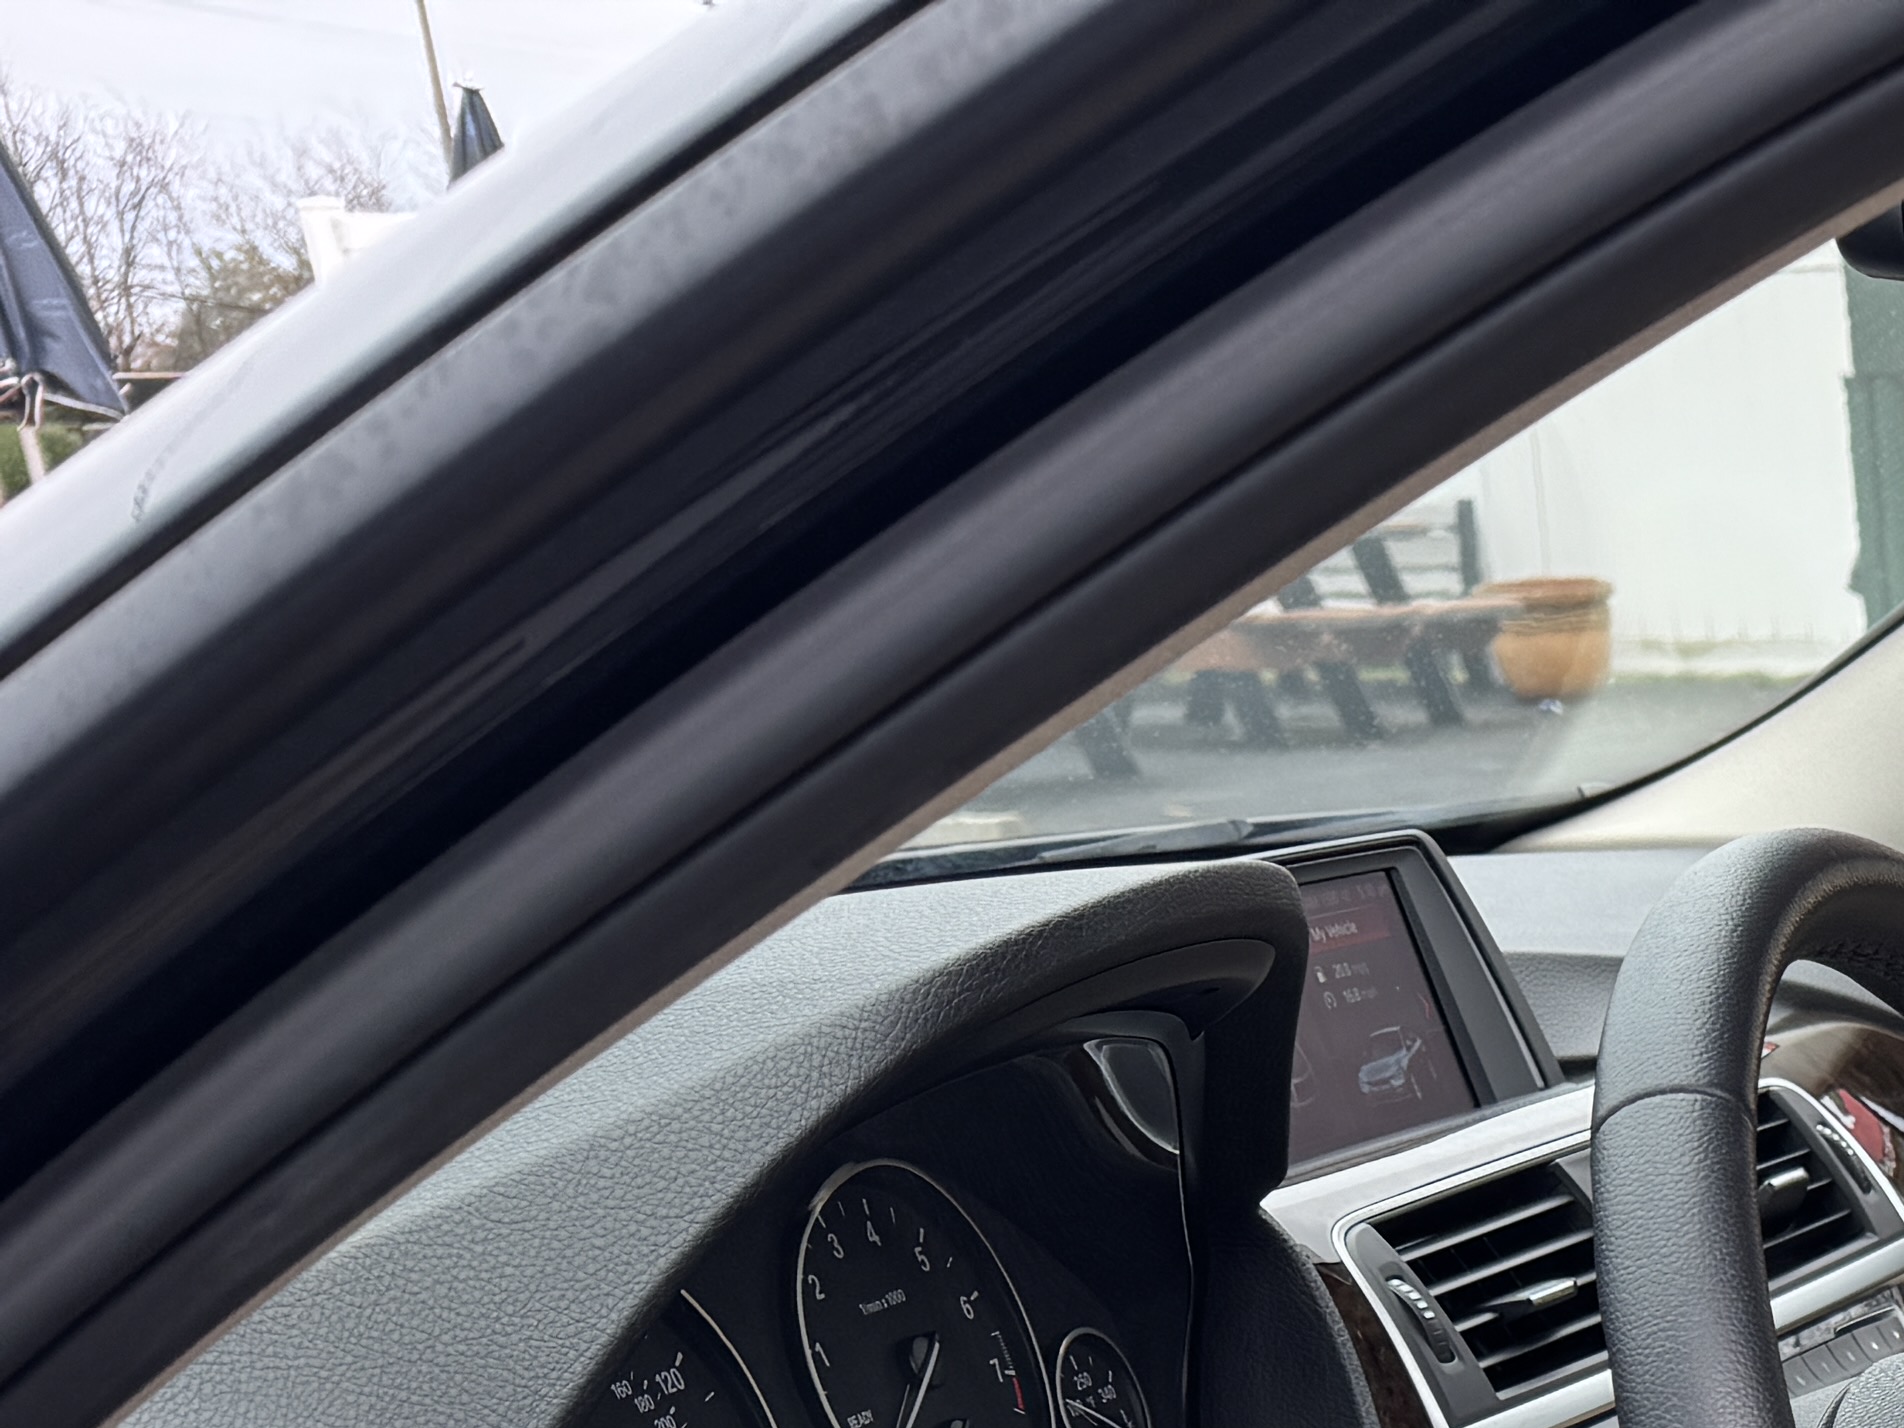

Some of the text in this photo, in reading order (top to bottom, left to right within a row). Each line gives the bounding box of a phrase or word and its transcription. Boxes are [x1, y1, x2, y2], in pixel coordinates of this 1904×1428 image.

[827, 1233, 844, 1259] 3
[866, 1220, 881, 1247] 4
[914, 1246, 930, 1272] 5
[808, 1275, 825, 1300] 2
[960, 1295, 974, 1320] 6
[815, 1342, 830, 1367] 1
[655, 1368, 685, 1395] 120
[989, 1358, 1003, 1382] 7
[611, 1380, 632, 1400] 160
[634, 1394, 655, 1414] 180
